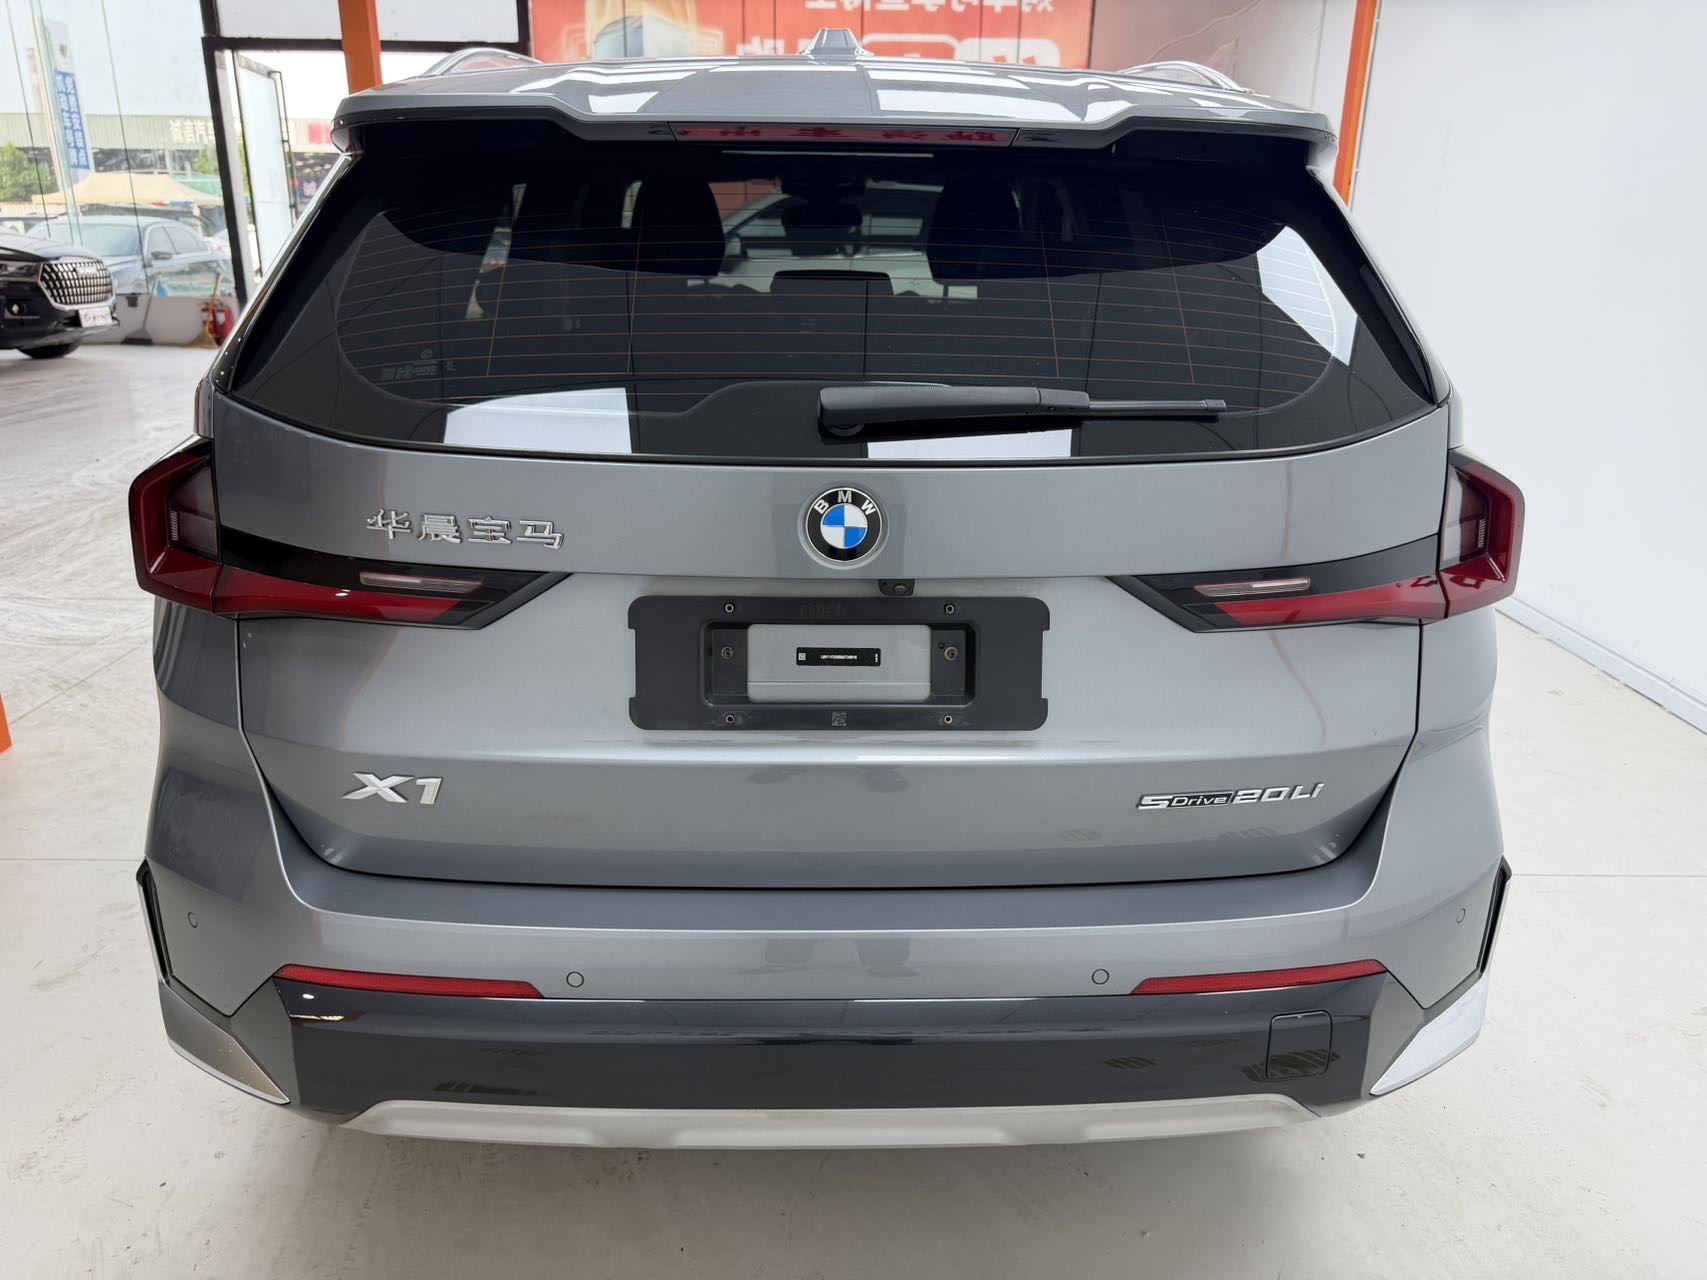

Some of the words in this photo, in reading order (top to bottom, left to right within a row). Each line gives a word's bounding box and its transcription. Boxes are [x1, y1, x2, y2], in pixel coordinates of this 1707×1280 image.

[813, 490, 877, 516] BMW
[366, 508, 565, 550] 华晨宝马
[341, 771, 443, 805] X1
